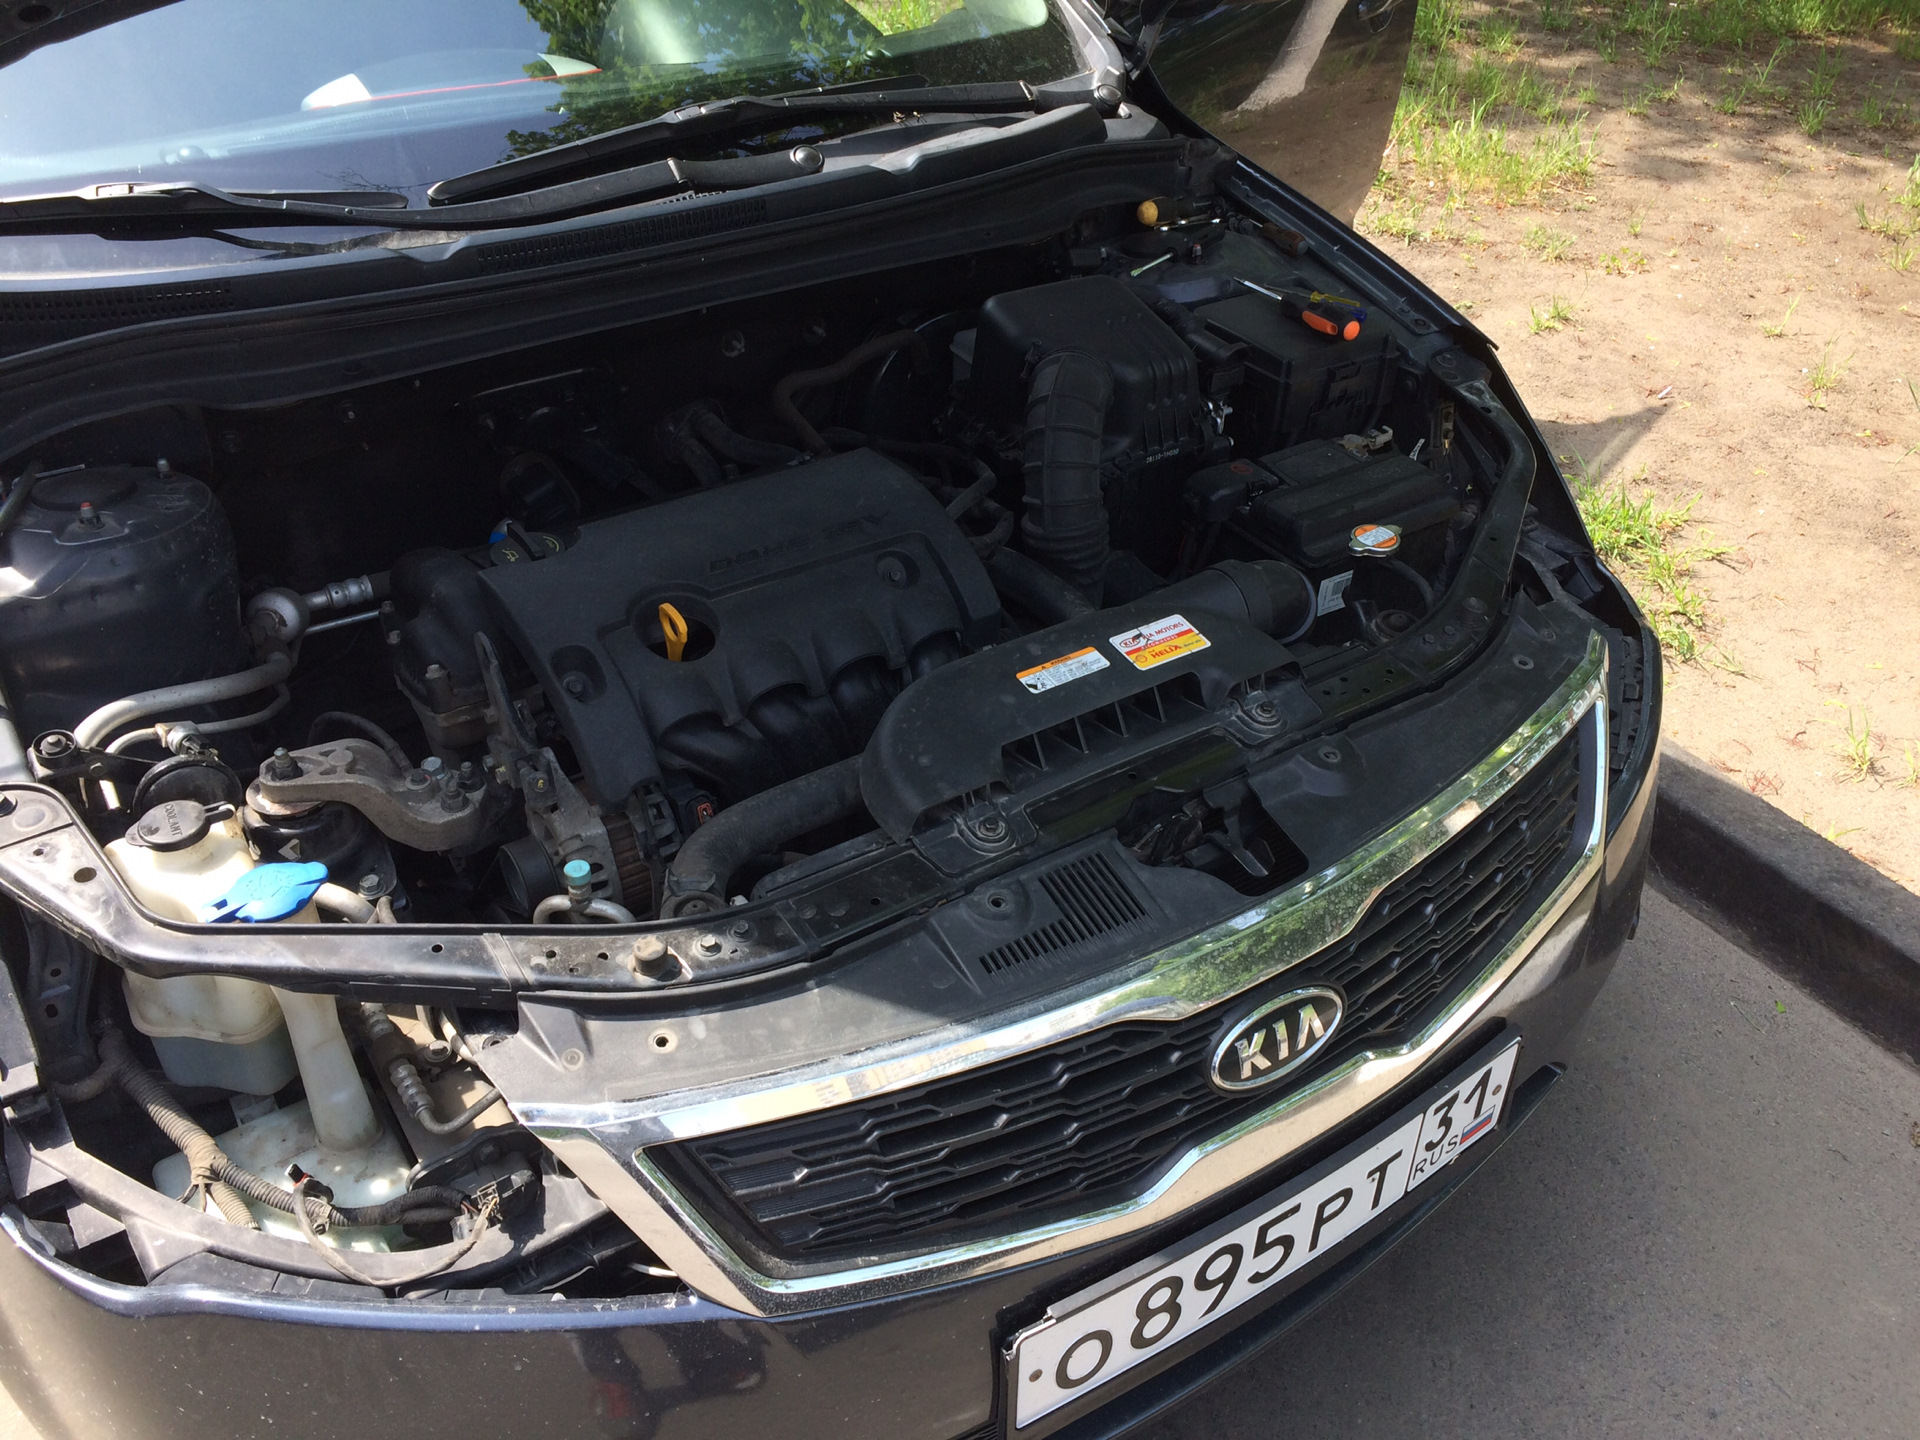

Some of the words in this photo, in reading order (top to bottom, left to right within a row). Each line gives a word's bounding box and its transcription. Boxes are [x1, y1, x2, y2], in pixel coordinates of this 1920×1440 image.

[1154, 621, 1184, 636] MOTORS
[1150, 644, 1183, 659] HELIX
[164, 803, 183, 836] COOLANT
[1234, 1003, 1325, 1080] KIA
[1413, 1134, 1459, 1181] RUS
